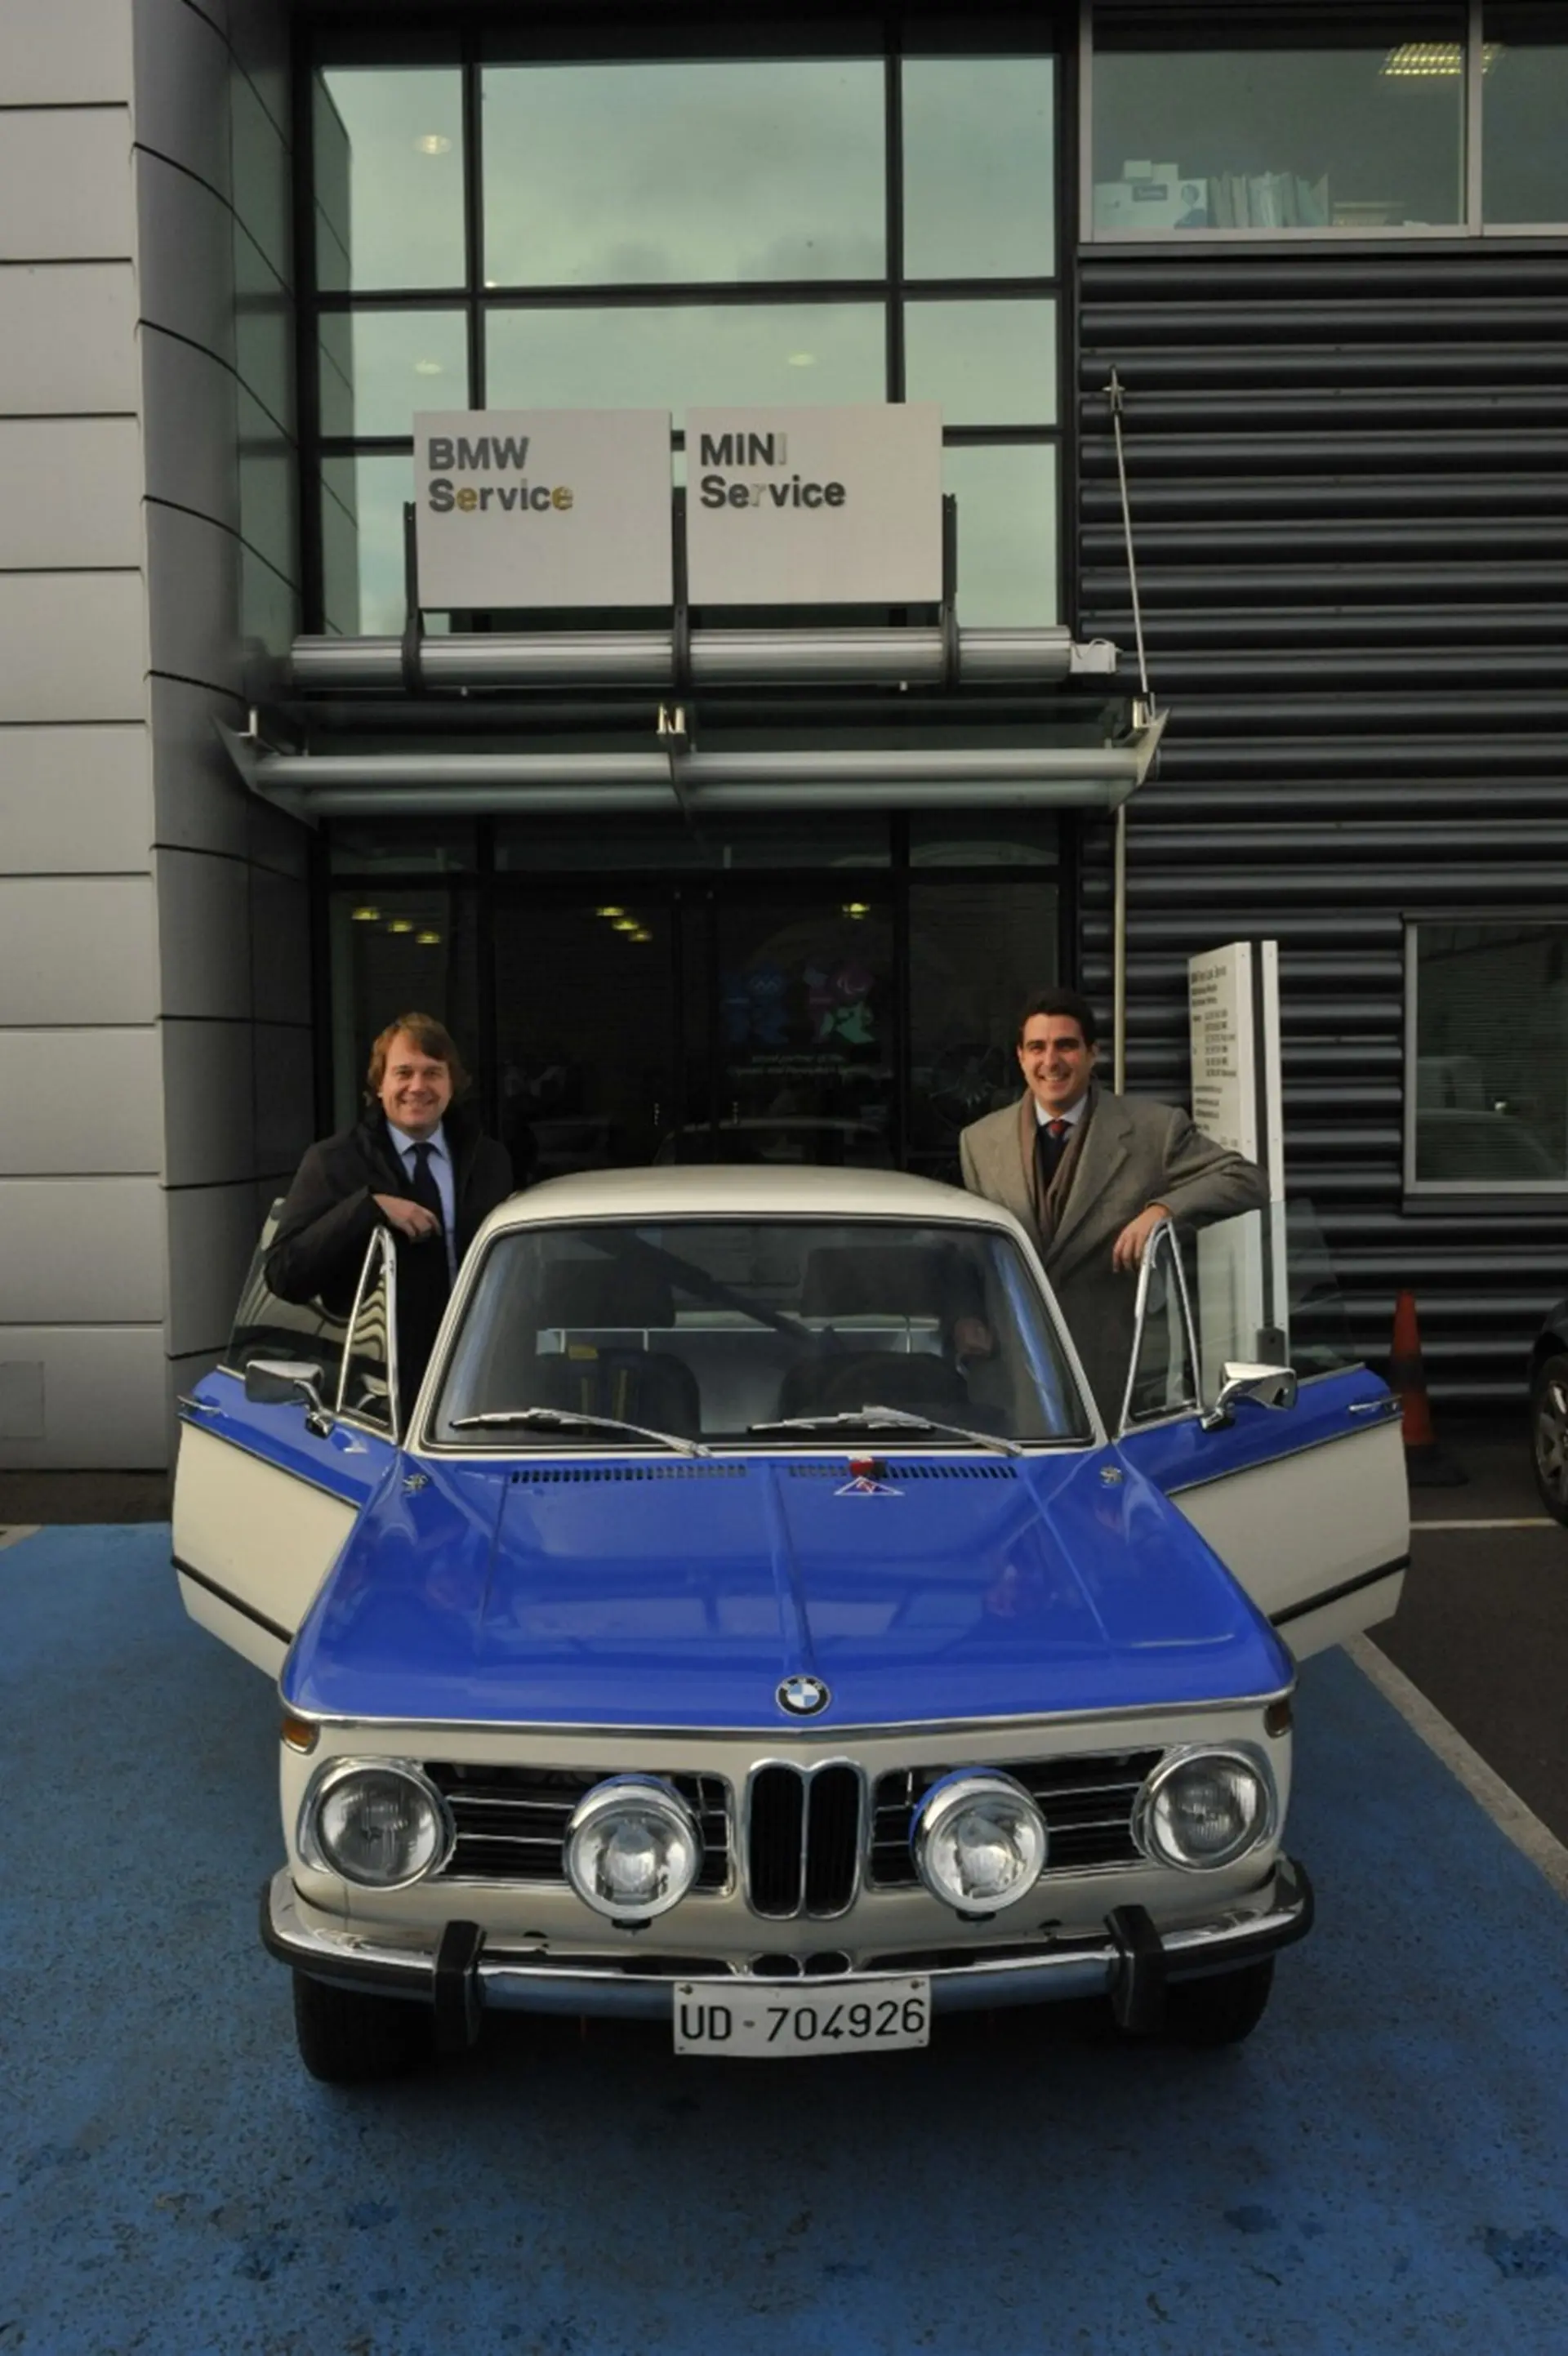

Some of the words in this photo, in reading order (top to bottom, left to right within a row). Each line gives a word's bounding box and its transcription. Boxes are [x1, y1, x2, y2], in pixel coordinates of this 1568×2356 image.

[429, 436, 528, 470] BMW
[429, 478, 573, 512] Service
[700, 474, 846, 508] Service
